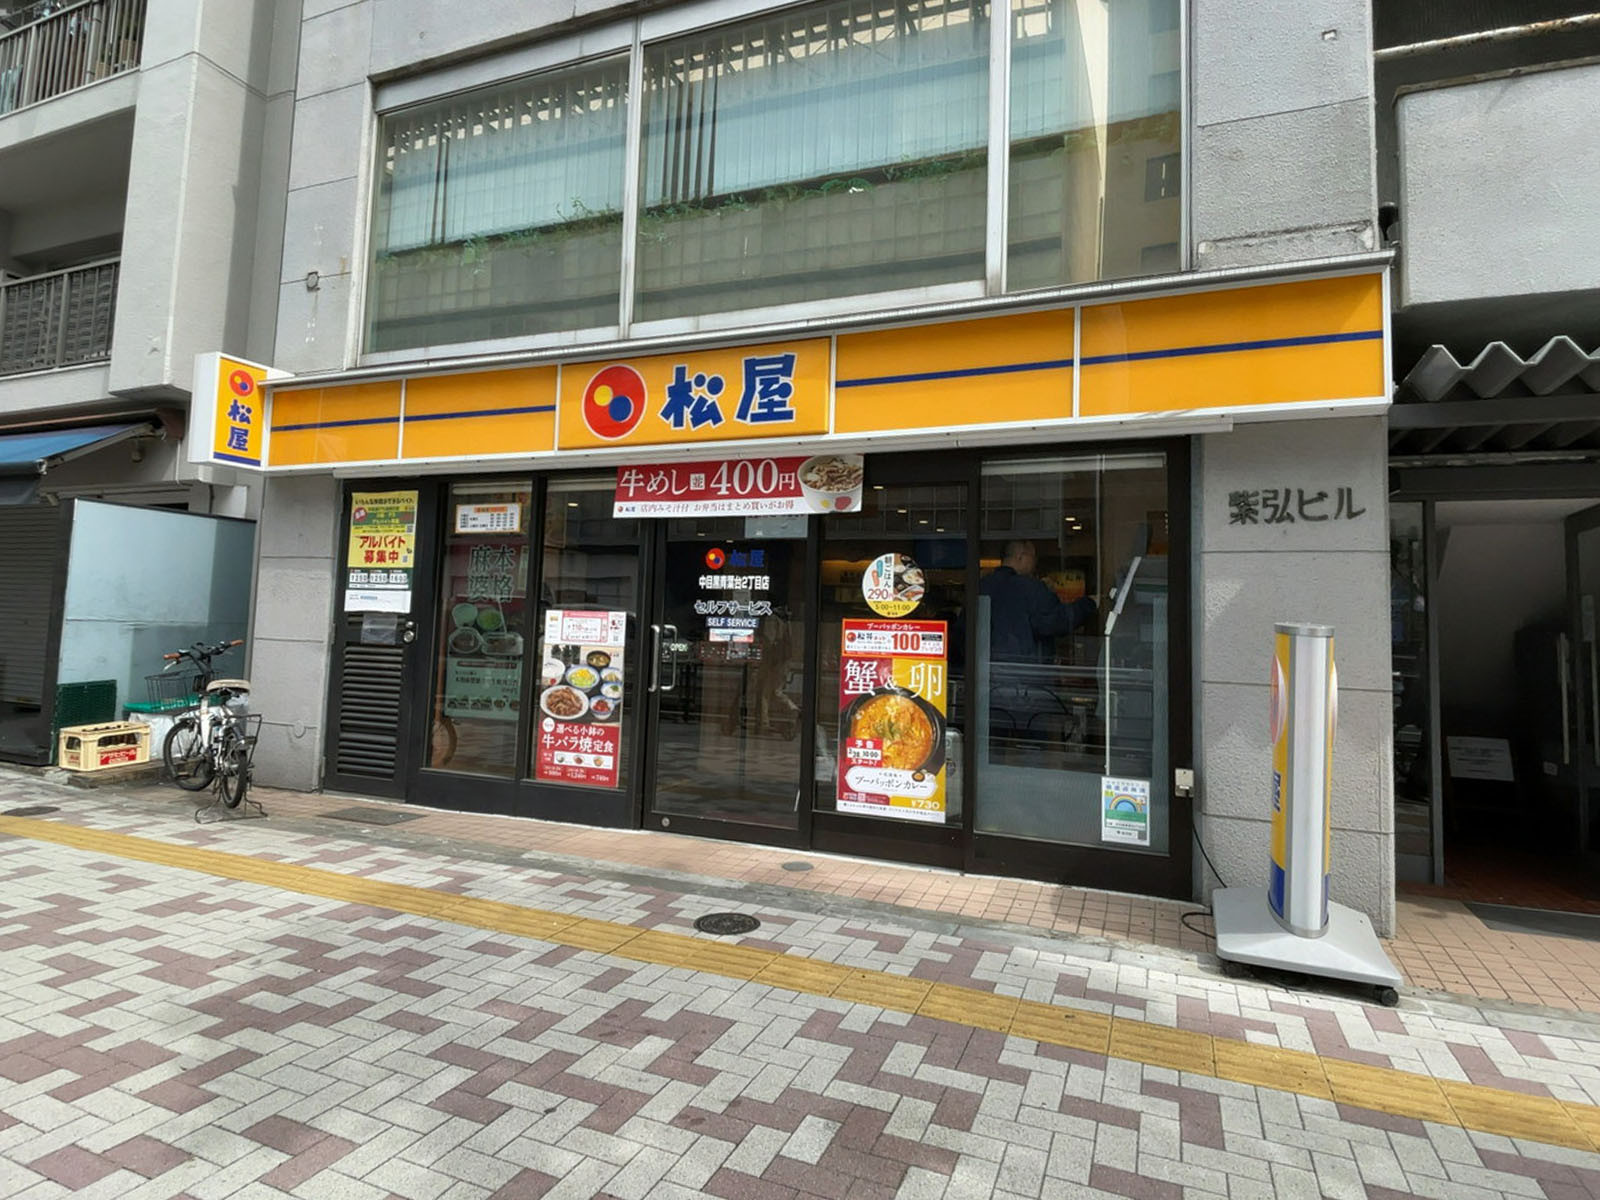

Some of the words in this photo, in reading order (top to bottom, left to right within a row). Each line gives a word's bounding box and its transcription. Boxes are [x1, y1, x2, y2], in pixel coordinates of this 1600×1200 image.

[660, 353, 797, 430] 松屋
[227, 399, 252, 451] 松屋
[620, 469, 689, 497] 牛めし
[710, 459, 795, 495] 400円
[694, 500, 794, 512] お弁当はまとめ買いがお得
[359, 536, 406, 548] アルバイト
[364, 550, 399, 563] 募集中
[729, 549, 765, 567] 松屋
[694, 600, 773, 616] セルフサービス
[707, 618, 725, 627] SELF
[727, 618, 757, 627] SERVICE
[891, 632, 921, 651] 100
[844, 659, 878, 696] 蟹
[884, 676, 898, 690] &
[908, 662, 943, 701] 卵
[542, 733, 614, 753] 牛バラ焼定食
